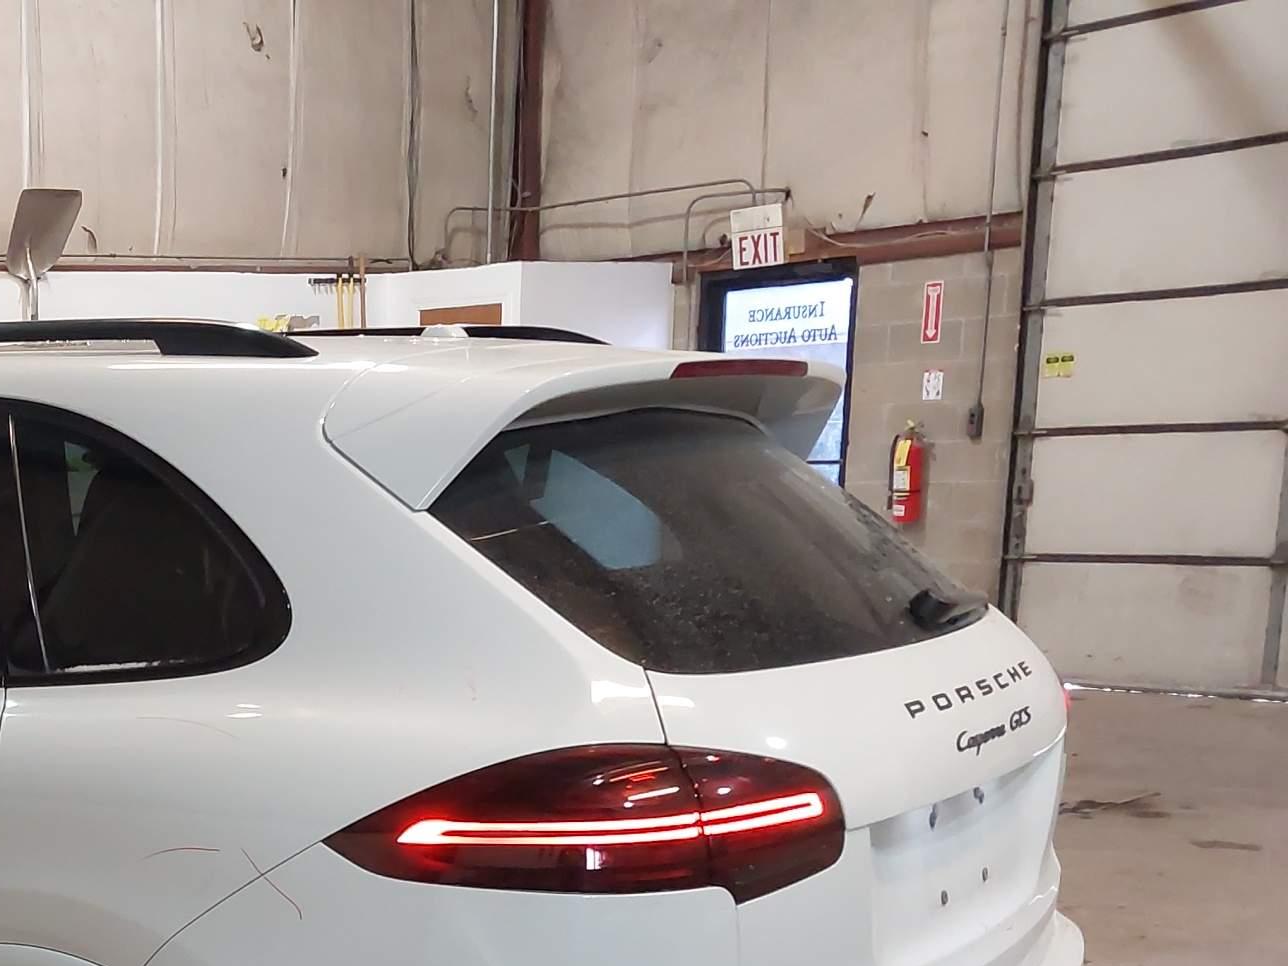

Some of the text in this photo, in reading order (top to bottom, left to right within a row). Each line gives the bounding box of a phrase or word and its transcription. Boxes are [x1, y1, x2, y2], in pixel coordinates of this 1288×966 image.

[739, 232, 779, 266] EXIT
[904, 661, 1033, 718] PORSCHE
[1009, 706, 1032, 731] GTS
